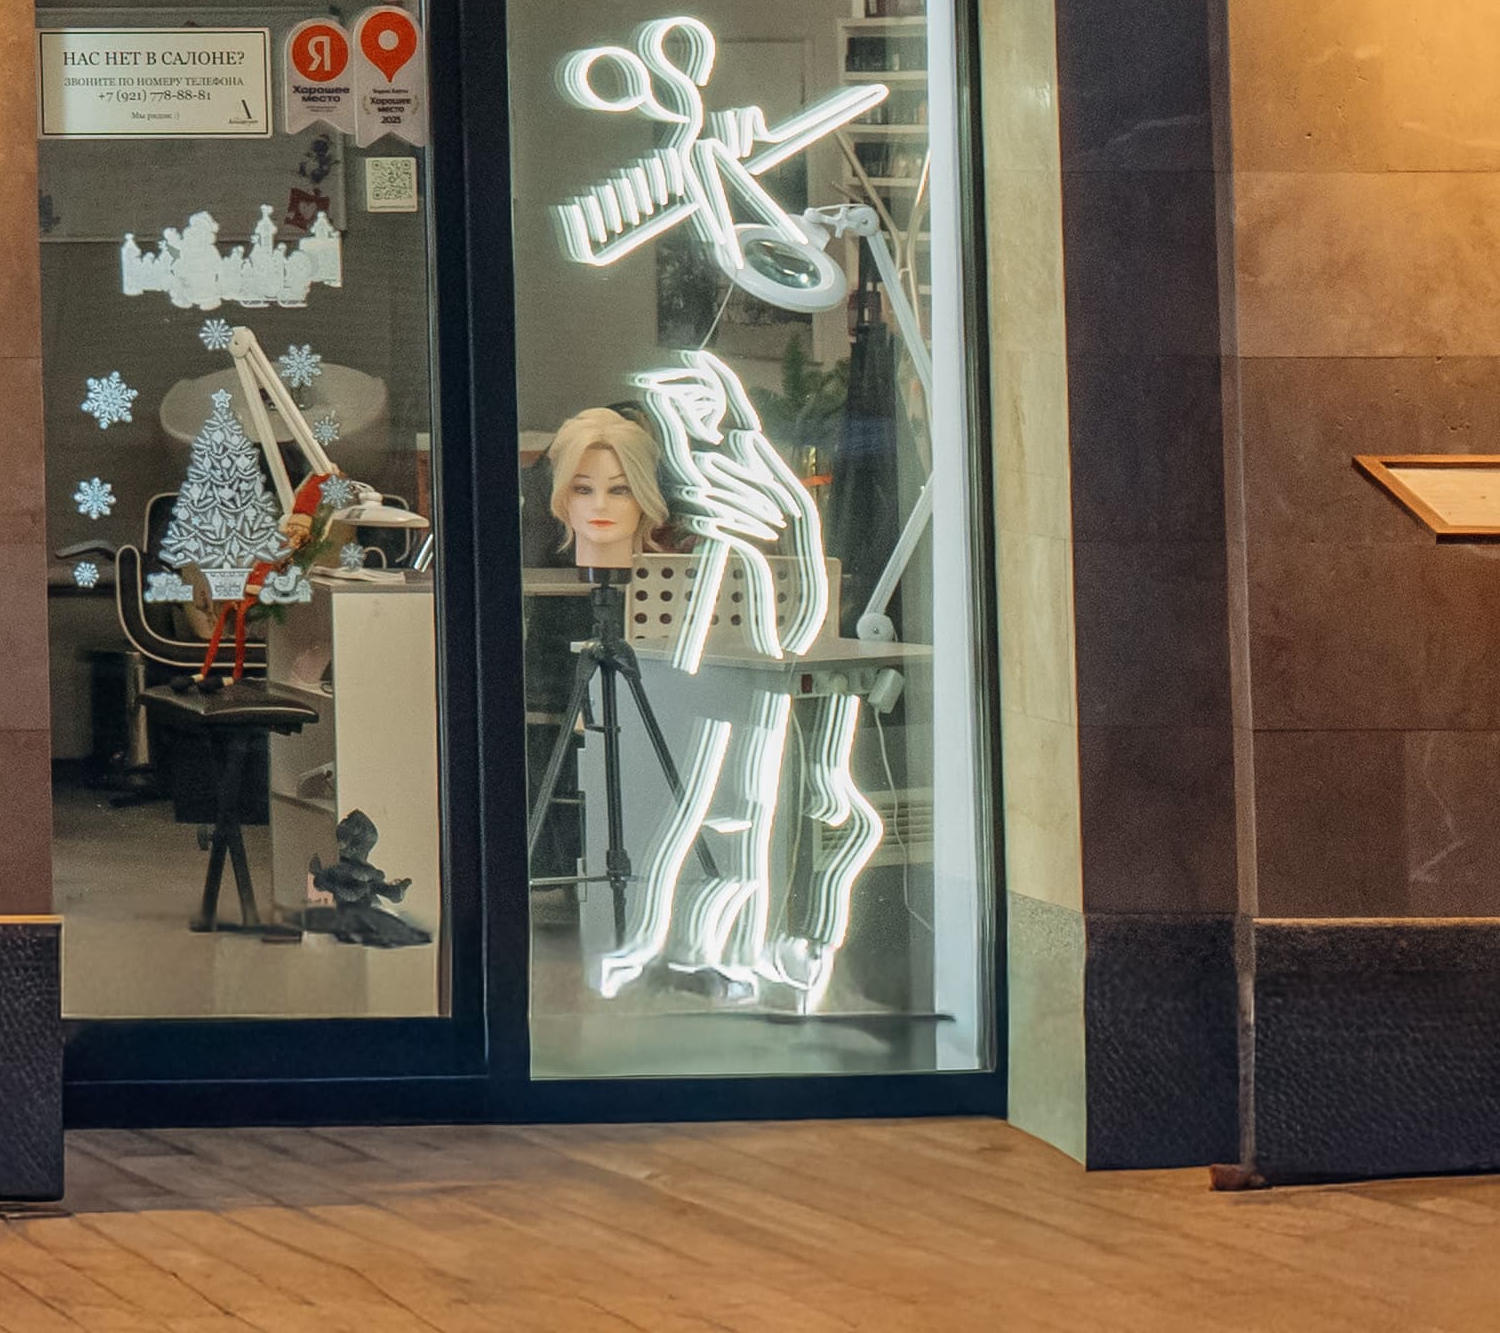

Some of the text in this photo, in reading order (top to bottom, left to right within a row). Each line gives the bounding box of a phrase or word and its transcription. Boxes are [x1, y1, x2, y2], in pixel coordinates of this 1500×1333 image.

[63, 51, 245, 66] НАС НЕТ В САЛОНЕ?
[307, 35, 332, 72] Я
[64, 77, 244, 86] ЗВОНИТЕ ПО НОМЕРУ ТЕЛЕФОНА
[99, 89, 211, 102] +7 (921) 778-88-81
[292, 85, 350, 96] Хорошее
[370, 96, 412, 105] Хорошее
